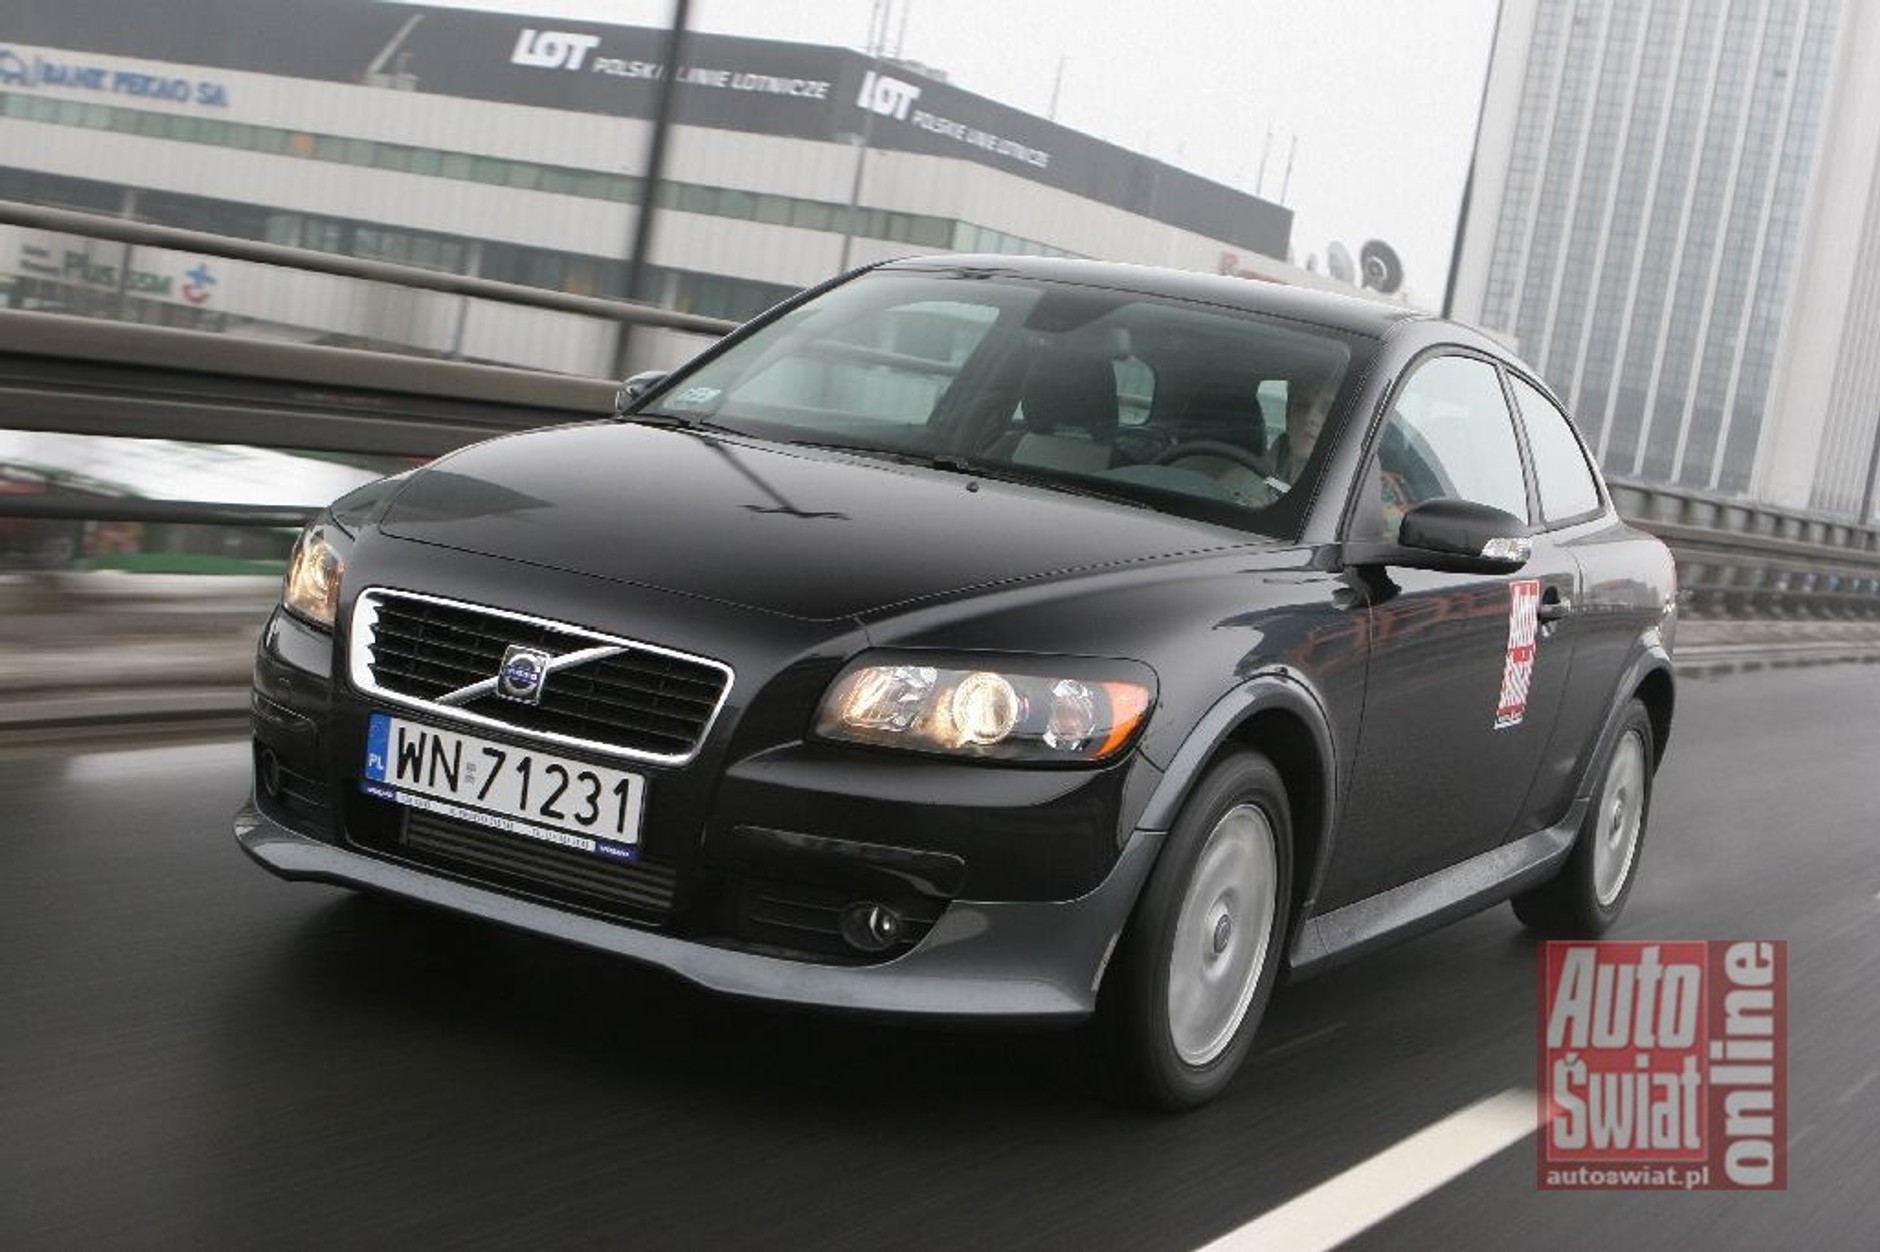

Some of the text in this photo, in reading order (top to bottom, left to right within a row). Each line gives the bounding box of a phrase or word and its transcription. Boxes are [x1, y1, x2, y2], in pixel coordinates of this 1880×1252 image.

[510, 29, 601, 71] LOT
[43, 61, 230, 107] BANK PEKAO SA
[731, 71, 831, 99] LOTNICZE
[857, 70, 922, 121] LOT
[368, 752, 384, 772] PL
[397, 727, 630, 834] WN 71231
